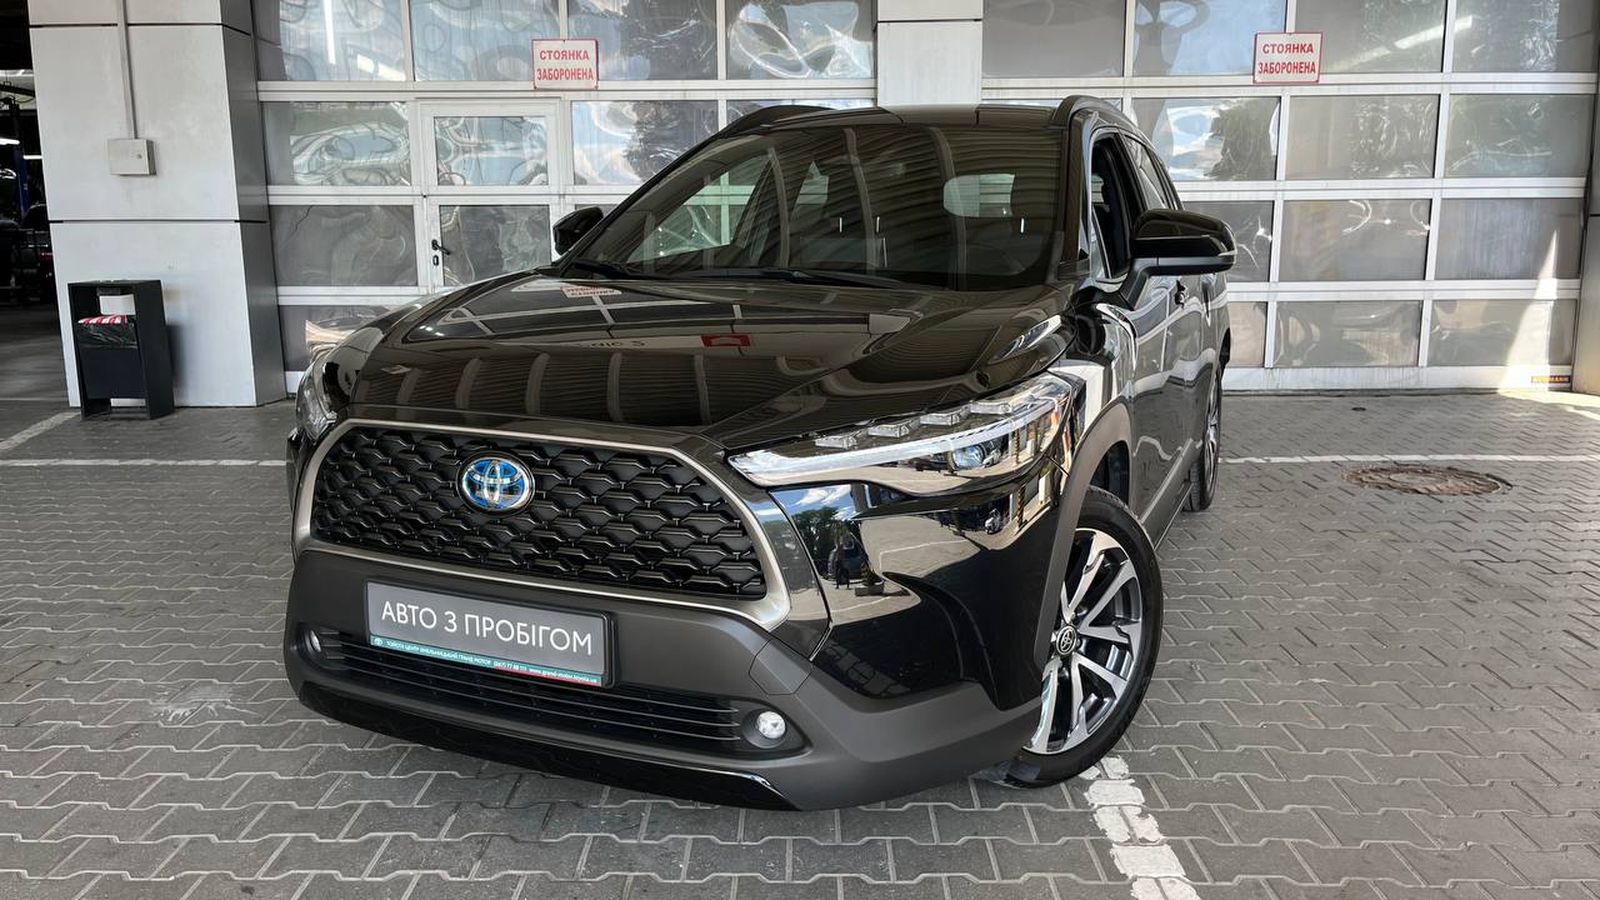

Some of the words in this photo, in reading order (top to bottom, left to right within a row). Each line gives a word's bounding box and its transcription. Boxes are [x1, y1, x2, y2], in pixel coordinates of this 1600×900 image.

[1263, 43, 1314, 54] СТОЯНКА
[540, 50, 589, 60] СТОЯНКА
[1258, 61, 1316, 74] ЗАБОРОНЕНА
[537, 68, 594, 80] ЗАБОРОНЕНА
[382, 601, 437, 629] АВТО
[465, 614, 591, 655] ПРОБІГОМ
